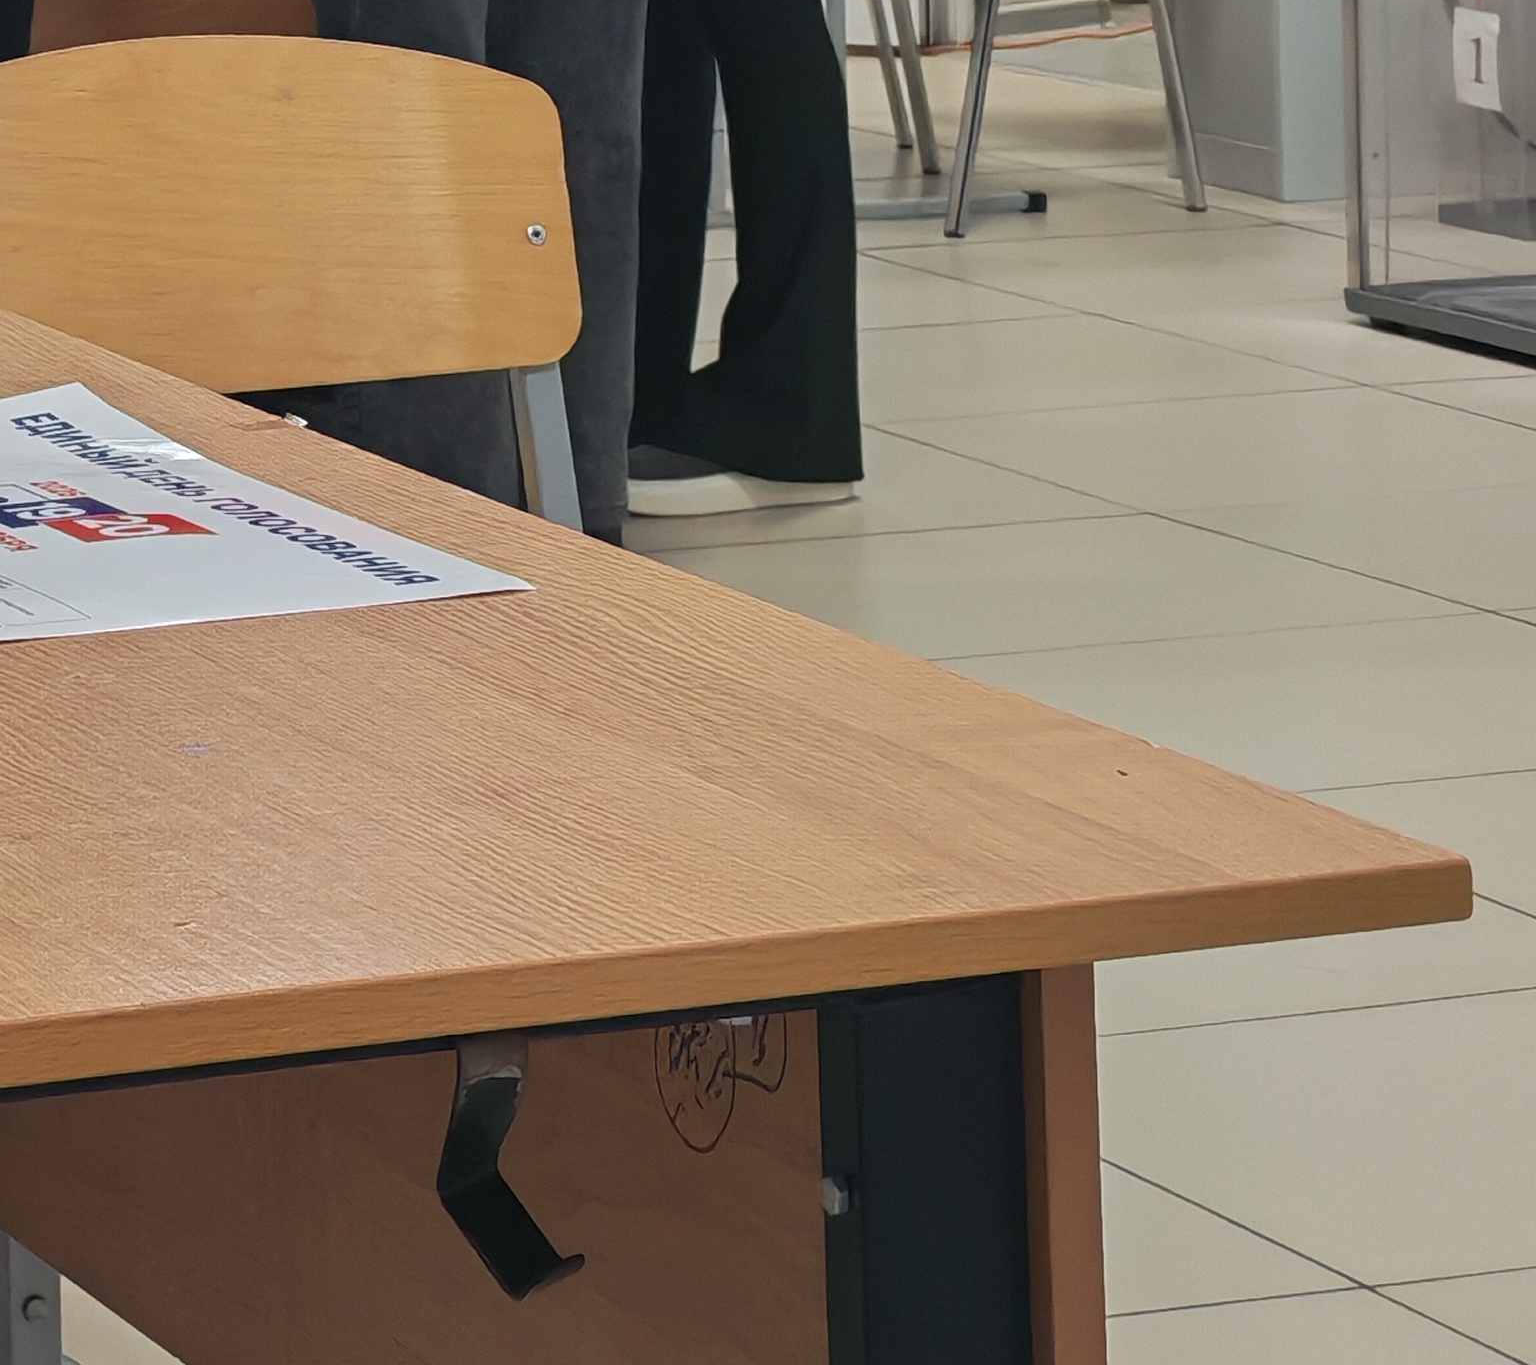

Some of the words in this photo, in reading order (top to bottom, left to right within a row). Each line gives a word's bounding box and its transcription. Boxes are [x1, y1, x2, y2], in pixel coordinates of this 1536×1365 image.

[1470, 37, 1485, 85] 1
[3, 502, 87, 519] 19
[73, 515, 170, 537] 20
[10, 411, 159, 469] ЕДИНЫЙ
[111, 469, 214, 496] ДЕНЬ
[193, 496, 441, 586] ГОЛОСОВАНИЯ
